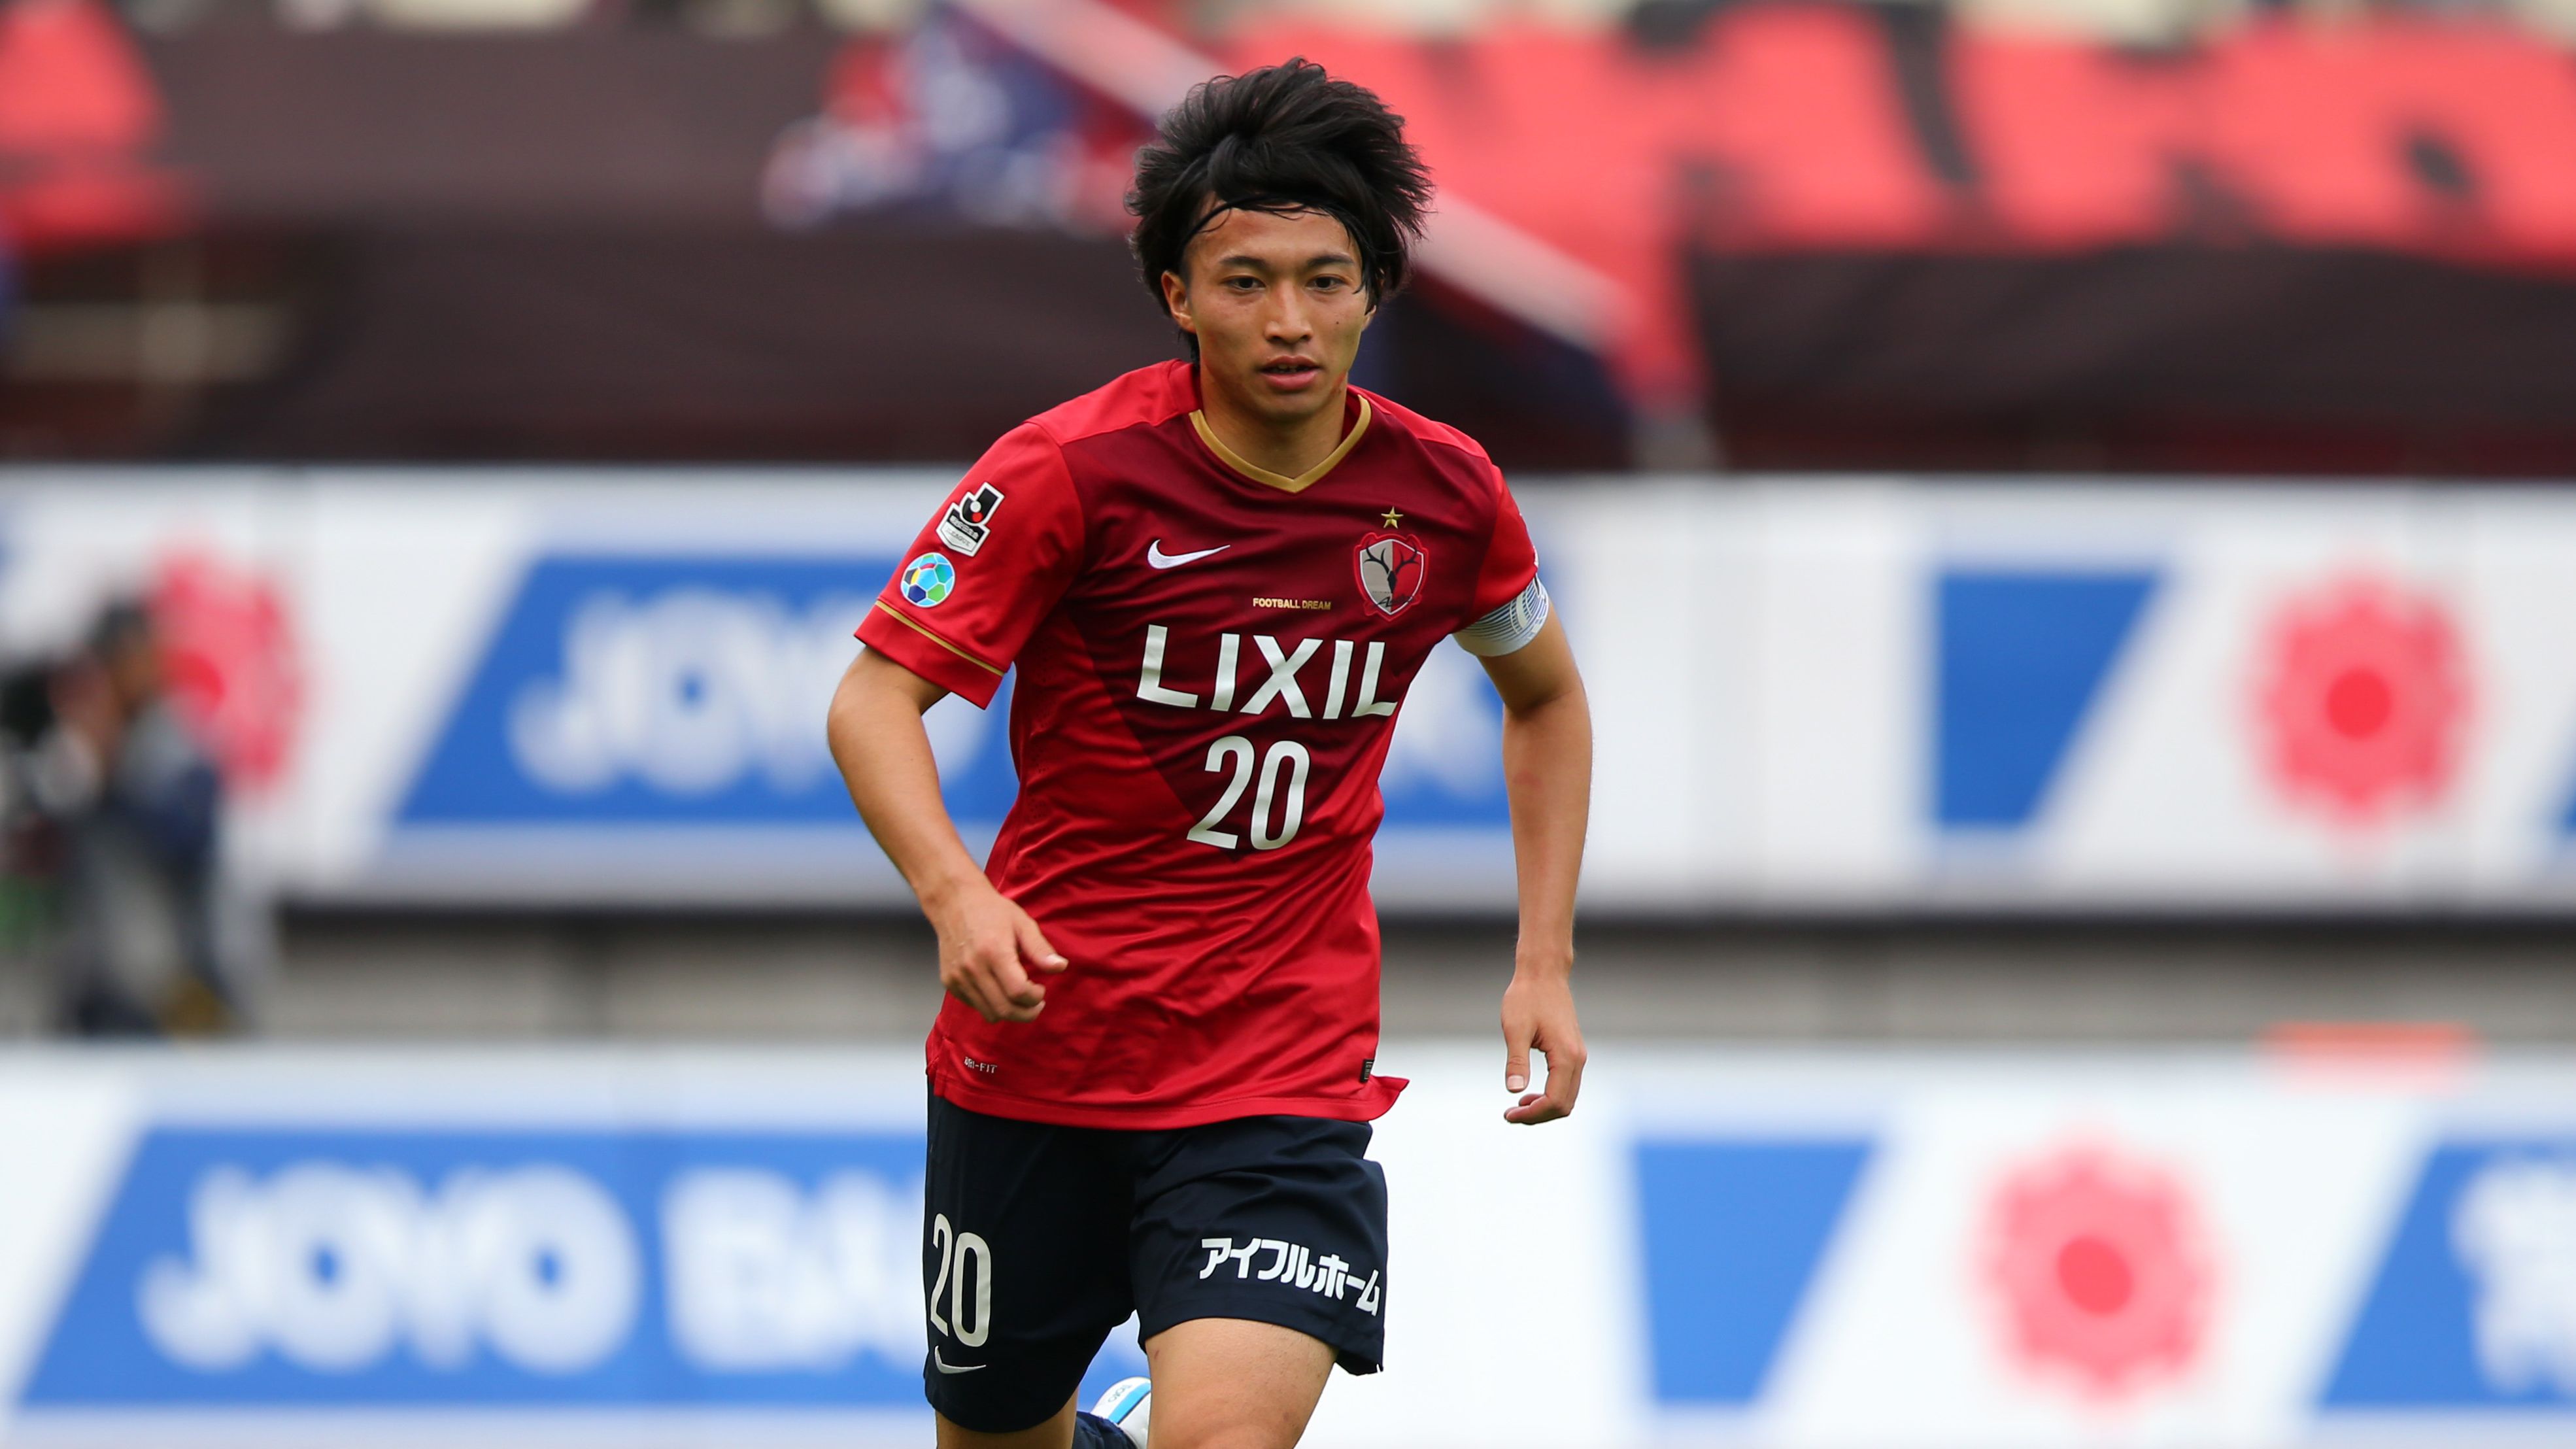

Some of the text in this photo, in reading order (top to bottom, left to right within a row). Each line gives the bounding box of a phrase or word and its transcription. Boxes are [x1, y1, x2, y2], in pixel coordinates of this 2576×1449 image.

[1252, 597, 1332, 610] FOOTBALL DREAM
[1136, 624, 1398, 720] LIXIL
[1186, 735, 1310, 850] 20
[139, 1161, 643, 1374] JOYO
[930, 1213, 991, 1348] 20
[1199, 1237, 1381, 1317] アイフルホーム
